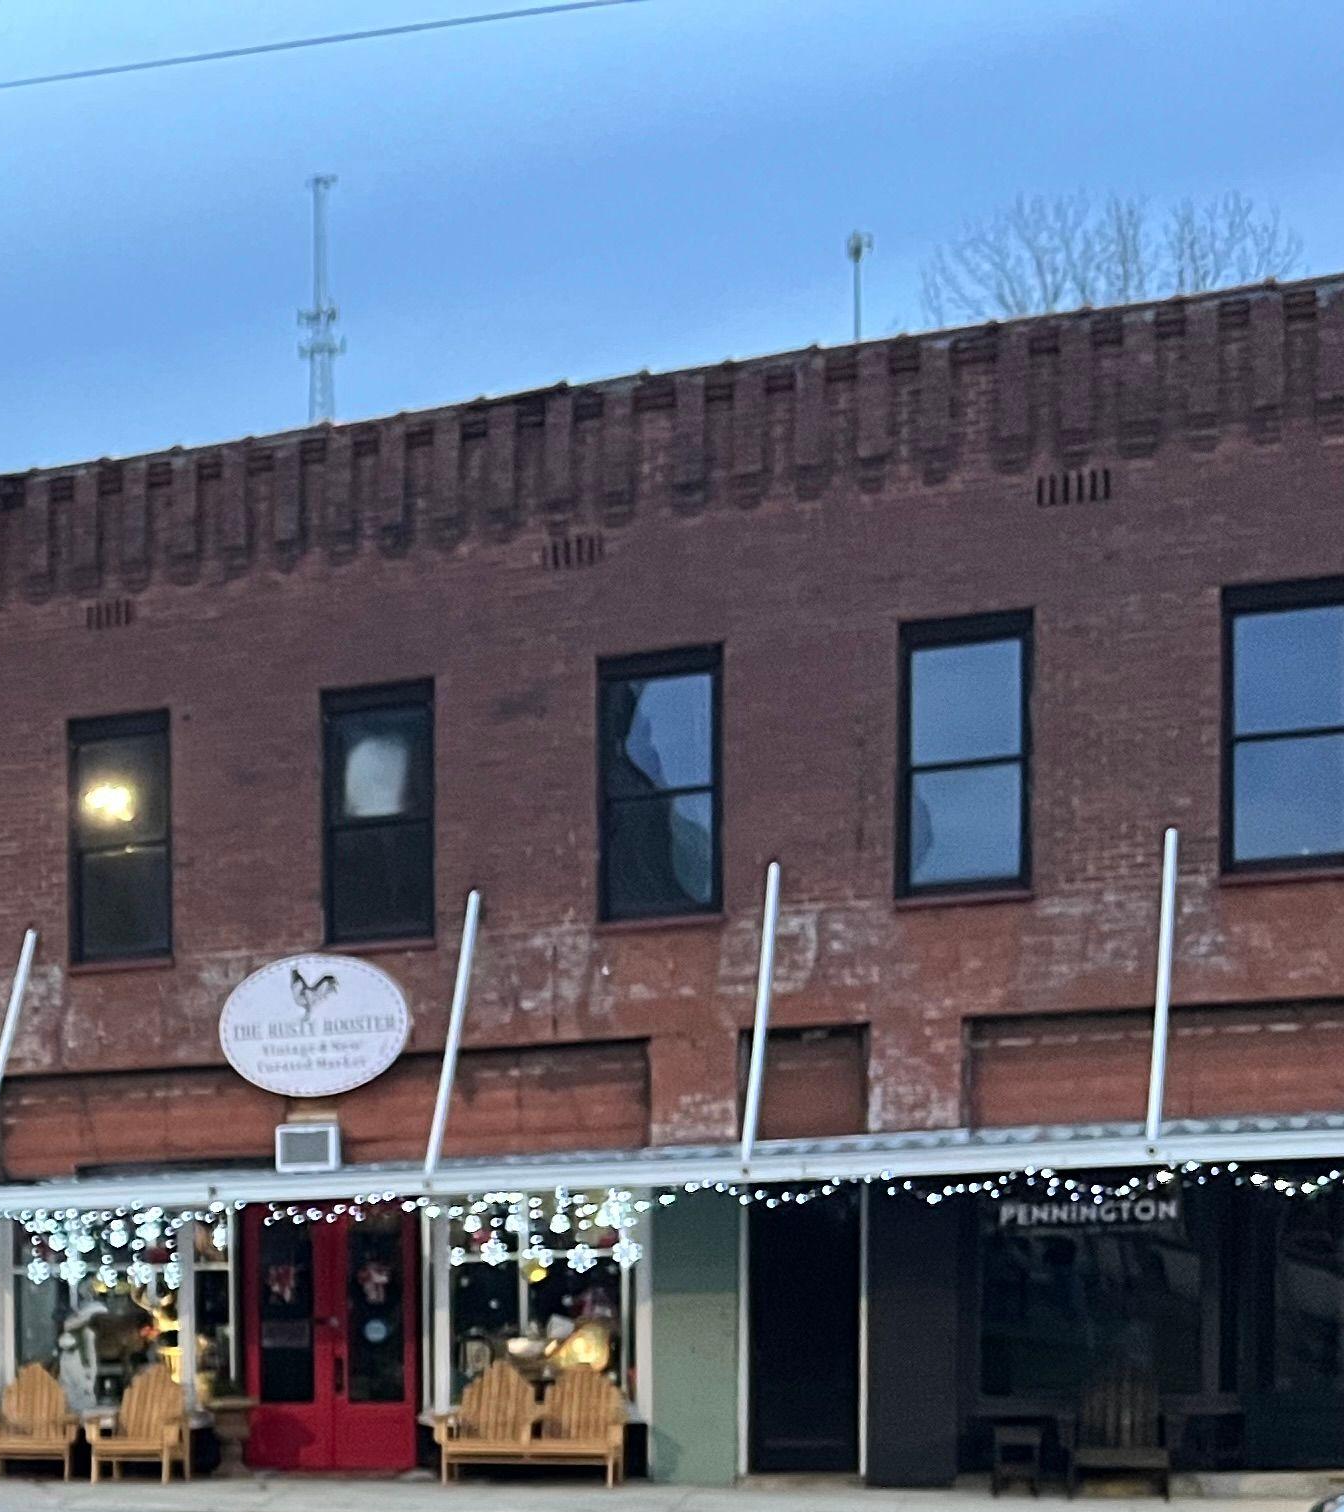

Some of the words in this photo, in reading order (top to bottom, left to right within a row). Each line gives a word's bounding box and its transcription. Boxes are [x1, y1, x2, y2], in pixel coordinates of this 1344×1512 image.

[233, 1023, 262, 1041] THE
[268, 1019, 316, 1038] RUSTY
[323, 1014, 396, 1034] ROOSTER
[999, 1199, 1178, 1227] PENNINGTON
